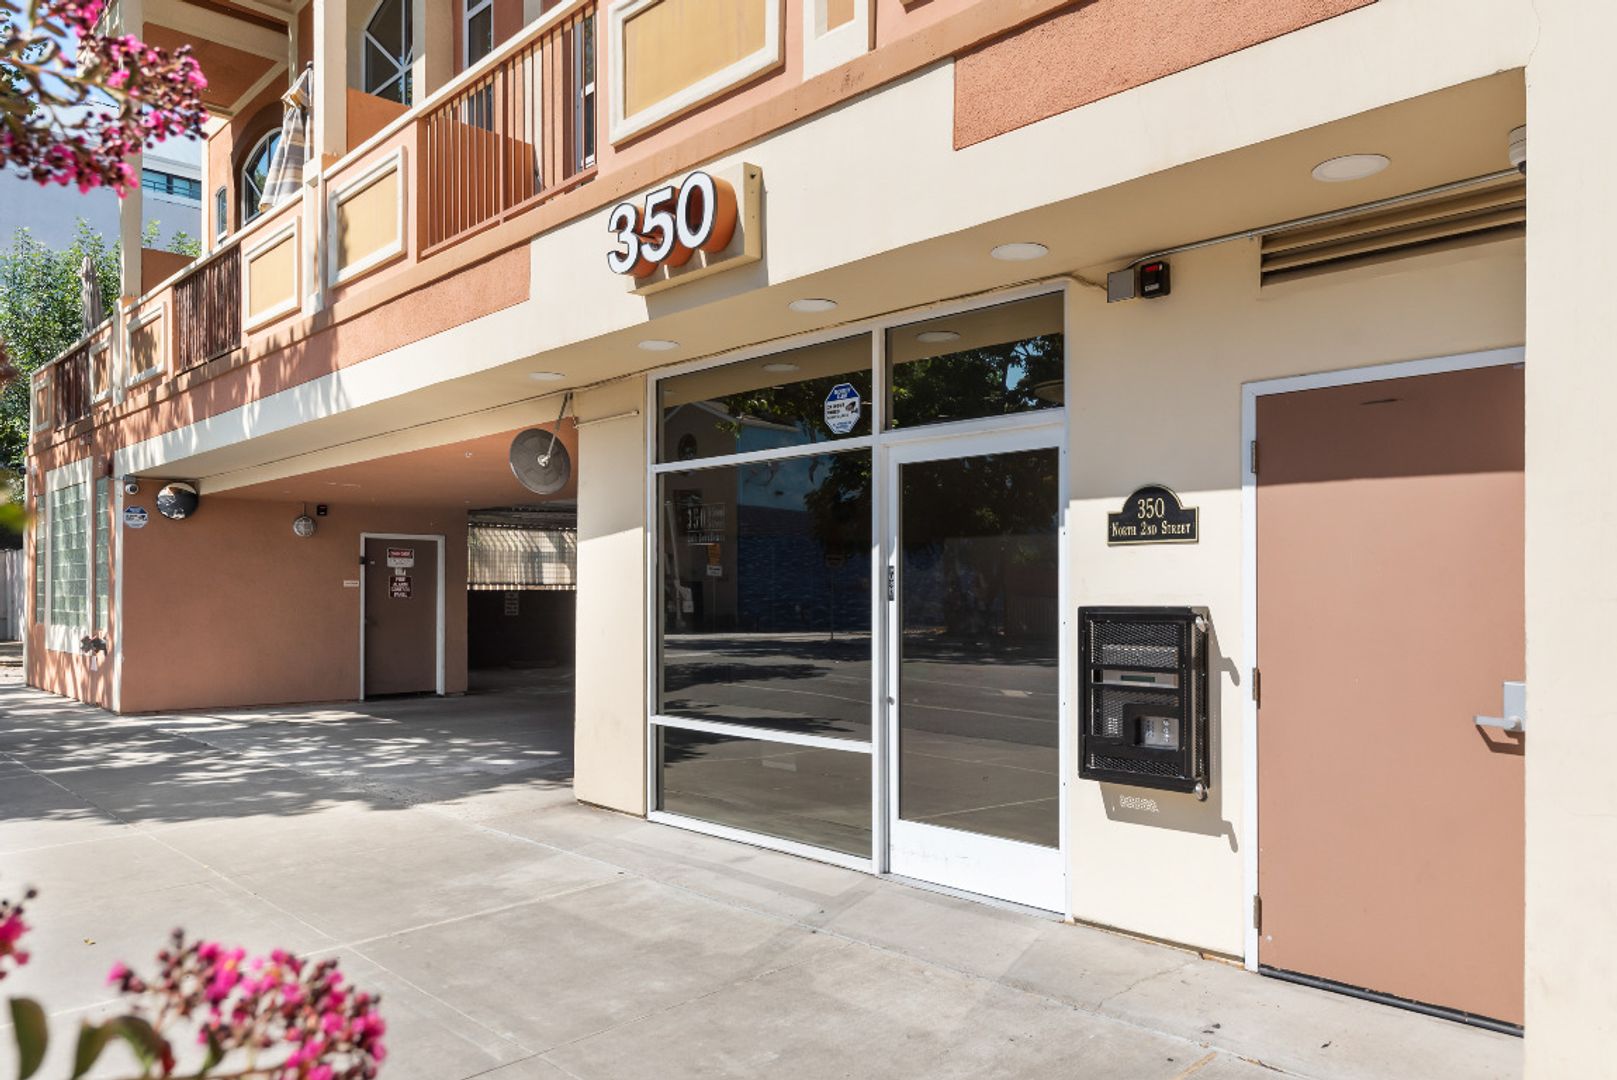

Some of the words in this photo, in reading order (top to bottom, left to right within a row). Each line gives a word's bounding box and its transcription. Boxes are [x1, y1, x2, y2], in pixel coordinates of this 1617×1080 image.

[607, 171, 718, 275] 350
[1137, 497, 1165, 519] 350
[1161, 520, 1191, 535] STREET
